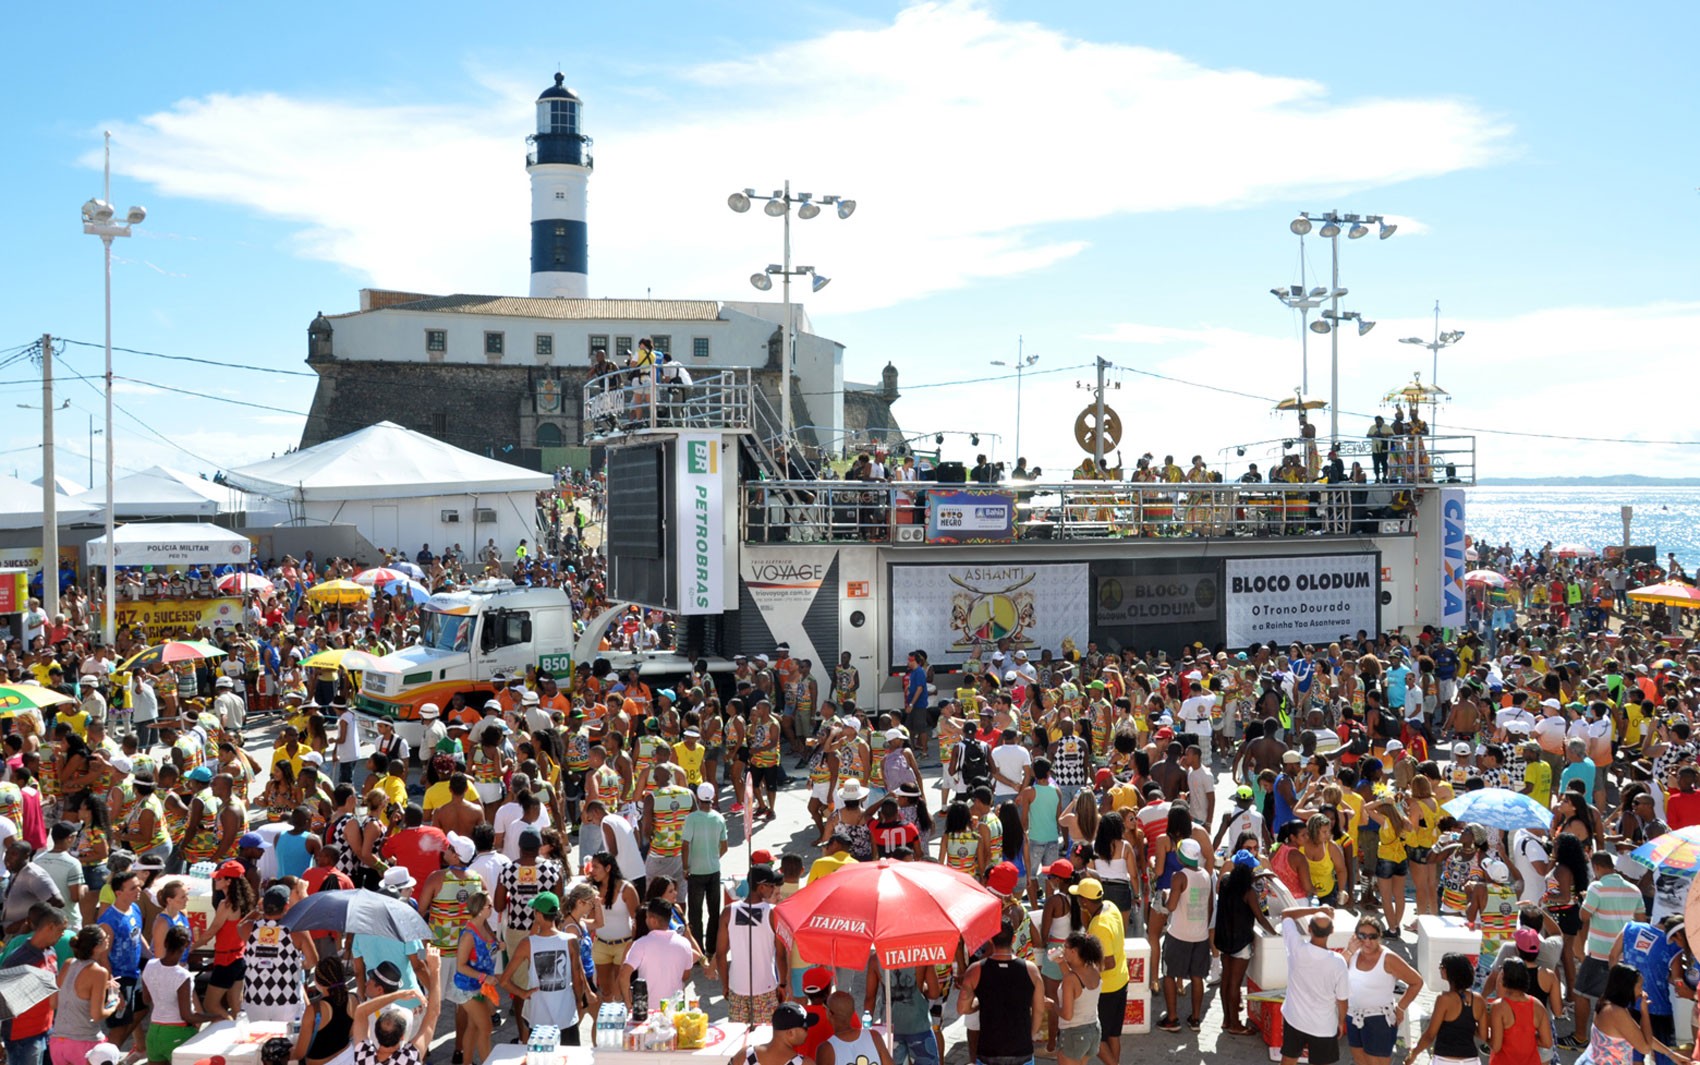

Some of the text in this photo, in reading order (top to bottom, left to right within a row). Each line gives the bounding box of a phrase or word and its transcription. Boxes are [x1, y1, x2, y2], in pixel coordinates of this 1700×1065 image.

[179, 544, 210, 552] MILITAR
[695, 485, 709, 609] PETROBRAS
[1444, 499, 1464, 617] CAIXA
[751, 564, 823, 581] VOYAGE
[964, 567, 1025, 581] ASHANTI
[1135, 583, 1189, 598] BLOCO
[1231, 571, 1371, 594] BLOCO OLODUM
[1127, 601, 1196, 617] OLODUM
[1252, 600, 1350, 616] O Trono Dourado
[153, 610, 202, 624] SUCESSO
[1265, 619, 1293, 630] Rainha
[542, 656, 569, 672] B50
[879, 827, 907, 854] 10
[809, 915, 867, 935] ITAIPAVA
[885, 945, 948, 966] ITAIPAVA
